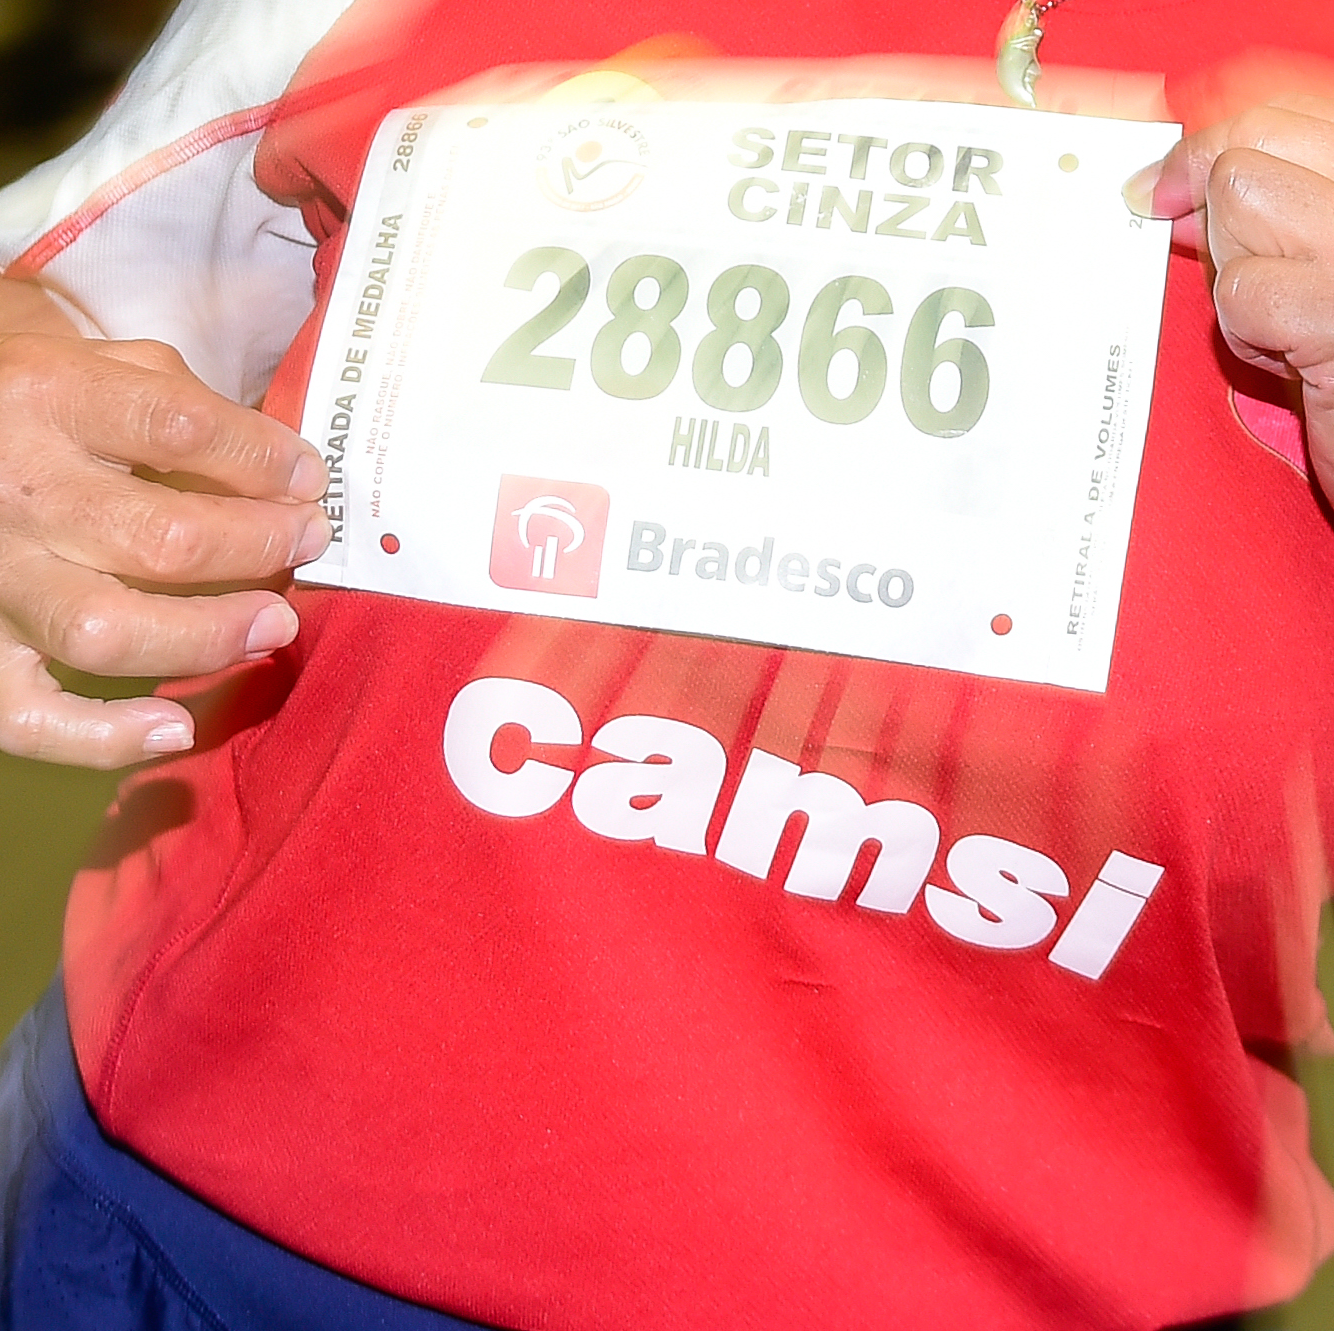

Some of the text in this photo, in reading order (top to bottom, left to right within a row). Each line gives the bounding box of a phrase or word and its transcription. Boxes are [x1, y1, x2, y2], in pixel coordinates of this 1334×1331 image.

[393, 113, 428, 173] 28866
[598, 118, 651, 156] SILVESTRE
[726, 126, 1004, 196] SETOR
[727, 176, 987, 246] CINZA
[352, 214, 403, 339] MEDALHA
[340, 348, 368, 383] DE
[480, 245, 996, 438] 28866
[1094, 344, 1121, 461] VOLUMES
[373, 444, 389, 484] COPIE
[668, 416, 770, 477] HILDA
[1088, 469, 1104, 502] DE
[627, 520, 915, 608] Bradesco
[442, 676, 1165, 980] camsi
